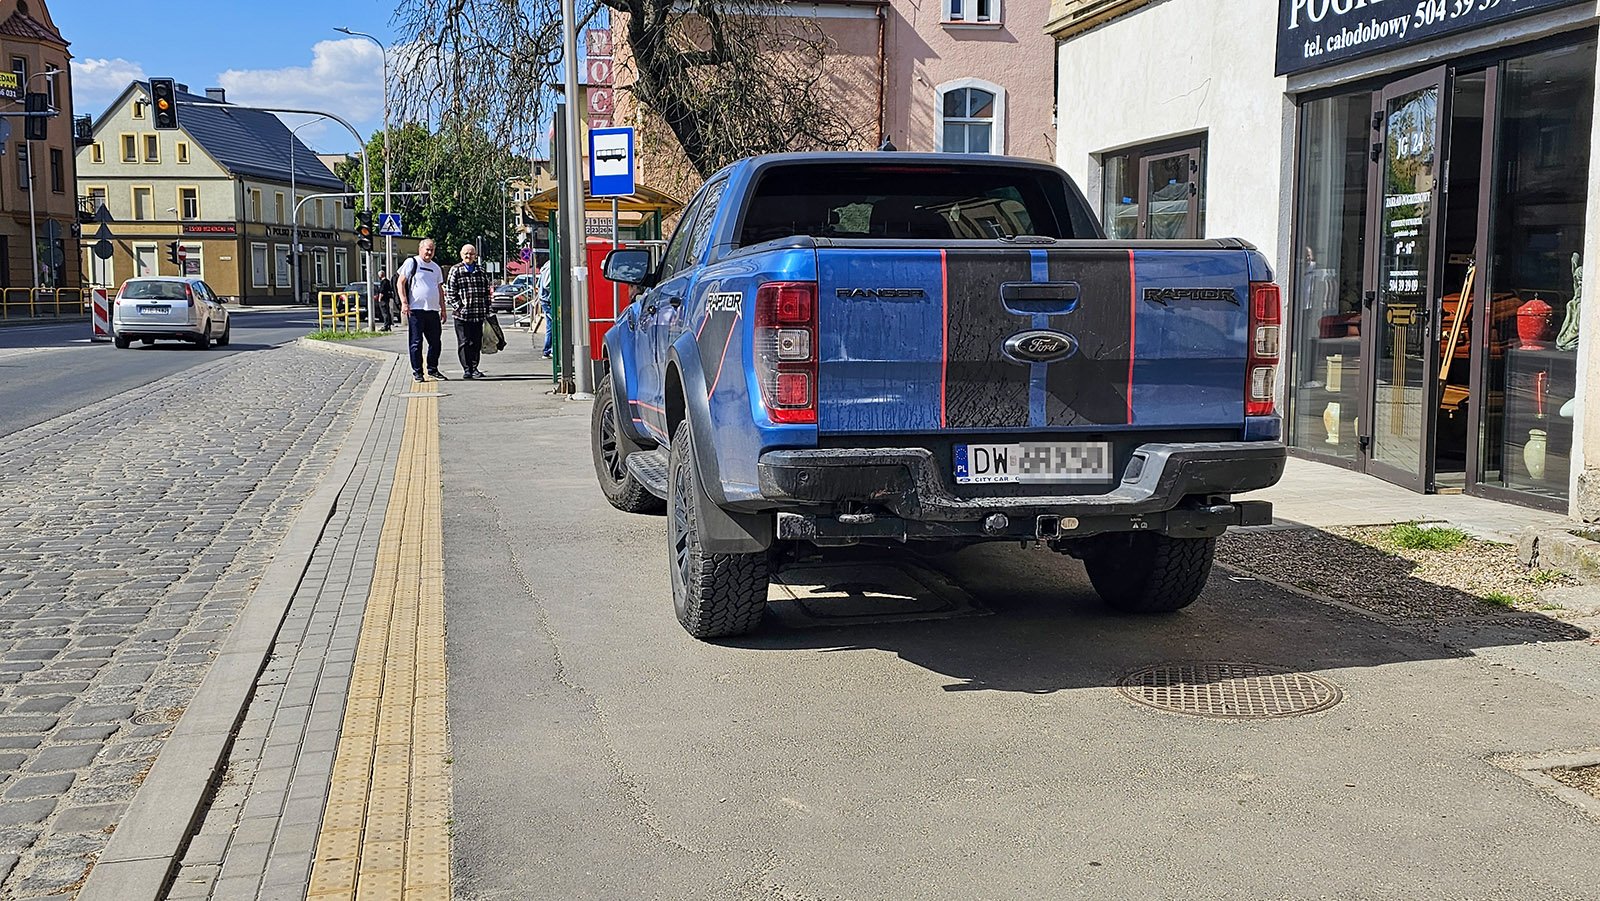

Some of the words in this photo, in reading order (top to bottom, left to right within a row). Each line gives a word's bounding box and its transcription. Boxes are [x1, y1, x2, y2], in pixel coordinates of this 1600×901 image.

[1304, 35, 1324, 58] tel.
[1327, 15, 1411, 52] całodobowy
[1414, 0, 1447, 28] 504
[1396, 137, 1408, 160] JG
[1413, 132, 1423, 152] 24
[835, 287, 924, 298] RANGER
[1142, 287, 1240, 307] RAPTOR
[707, 292, 742, 315] RAPTOR
[1029, 338, 1059, 352] Ford
[957, 465, 967, 473] PL
[974, 447, 1008, 474] DW
